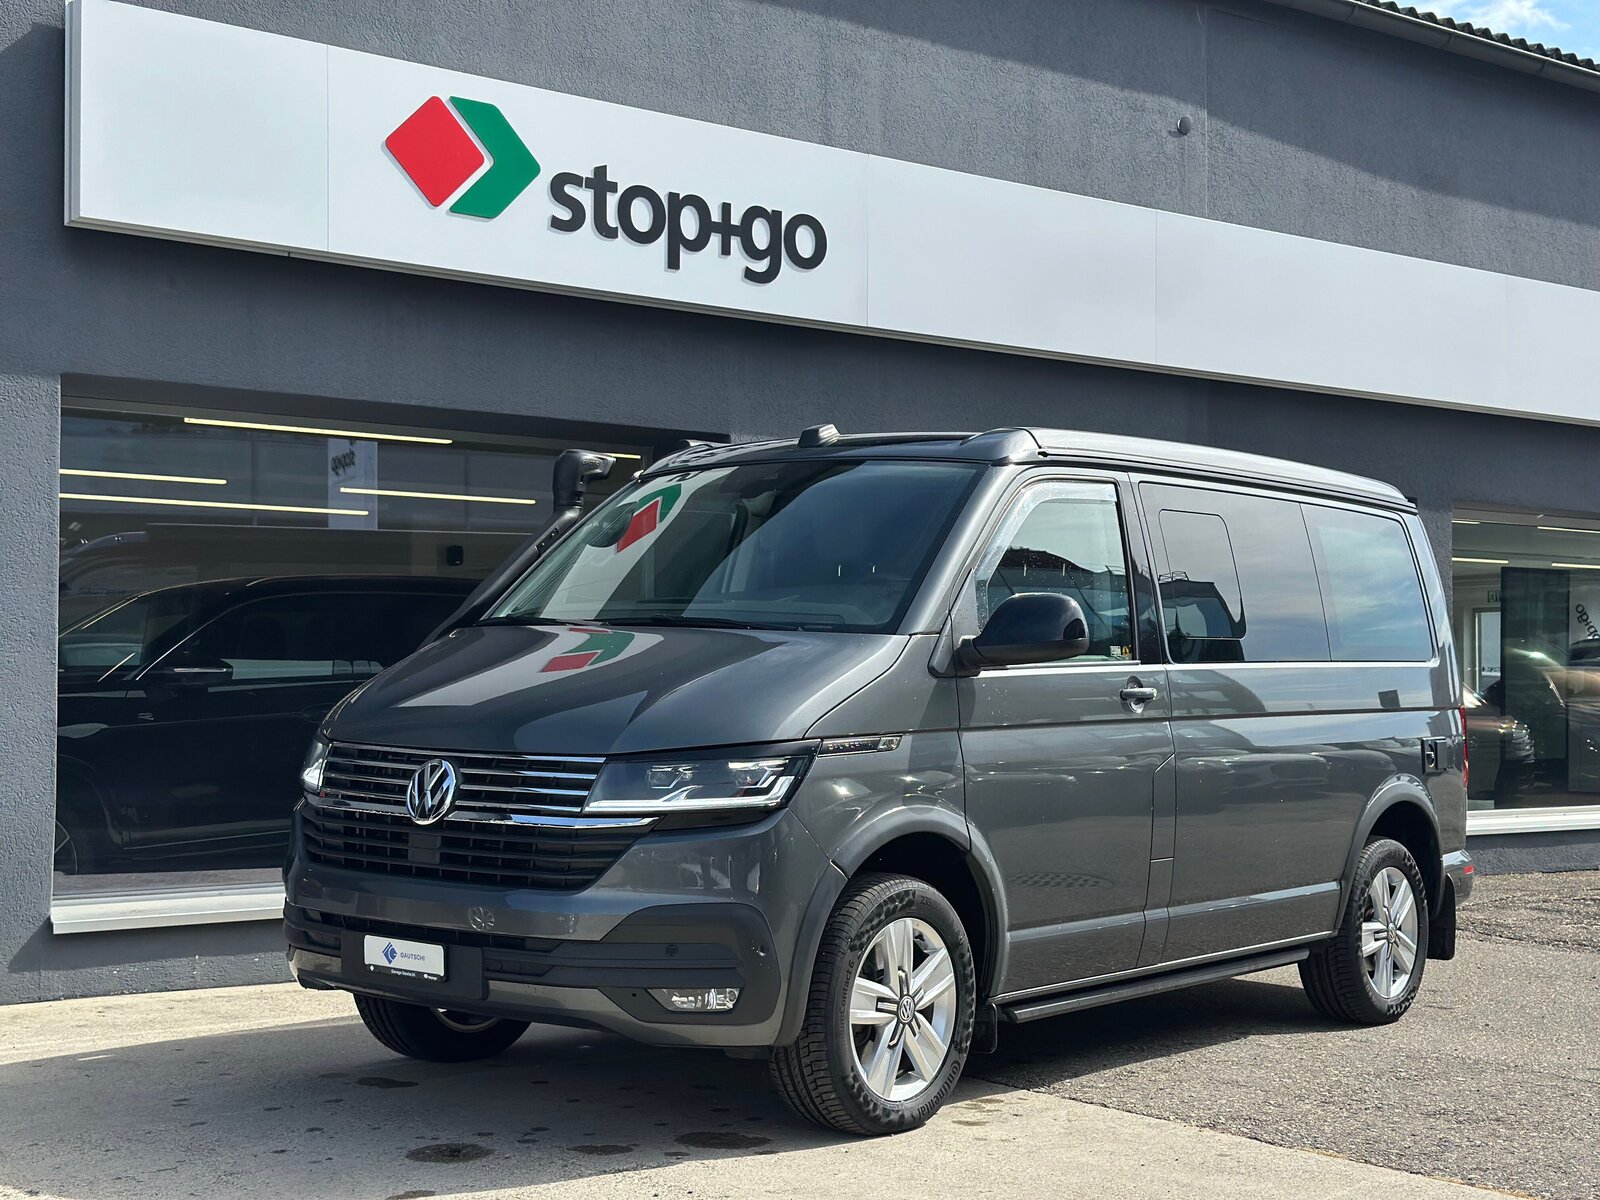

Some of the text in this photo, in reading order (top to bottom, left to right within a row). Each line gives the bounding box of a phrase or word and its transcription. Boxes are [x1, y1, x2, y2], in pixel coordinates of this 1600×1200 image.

[550, 164, 828, 284] stop+go
[400, 952, 426, 961] GAUTSCHI
[917, 1060, 961, 1121] Continental
